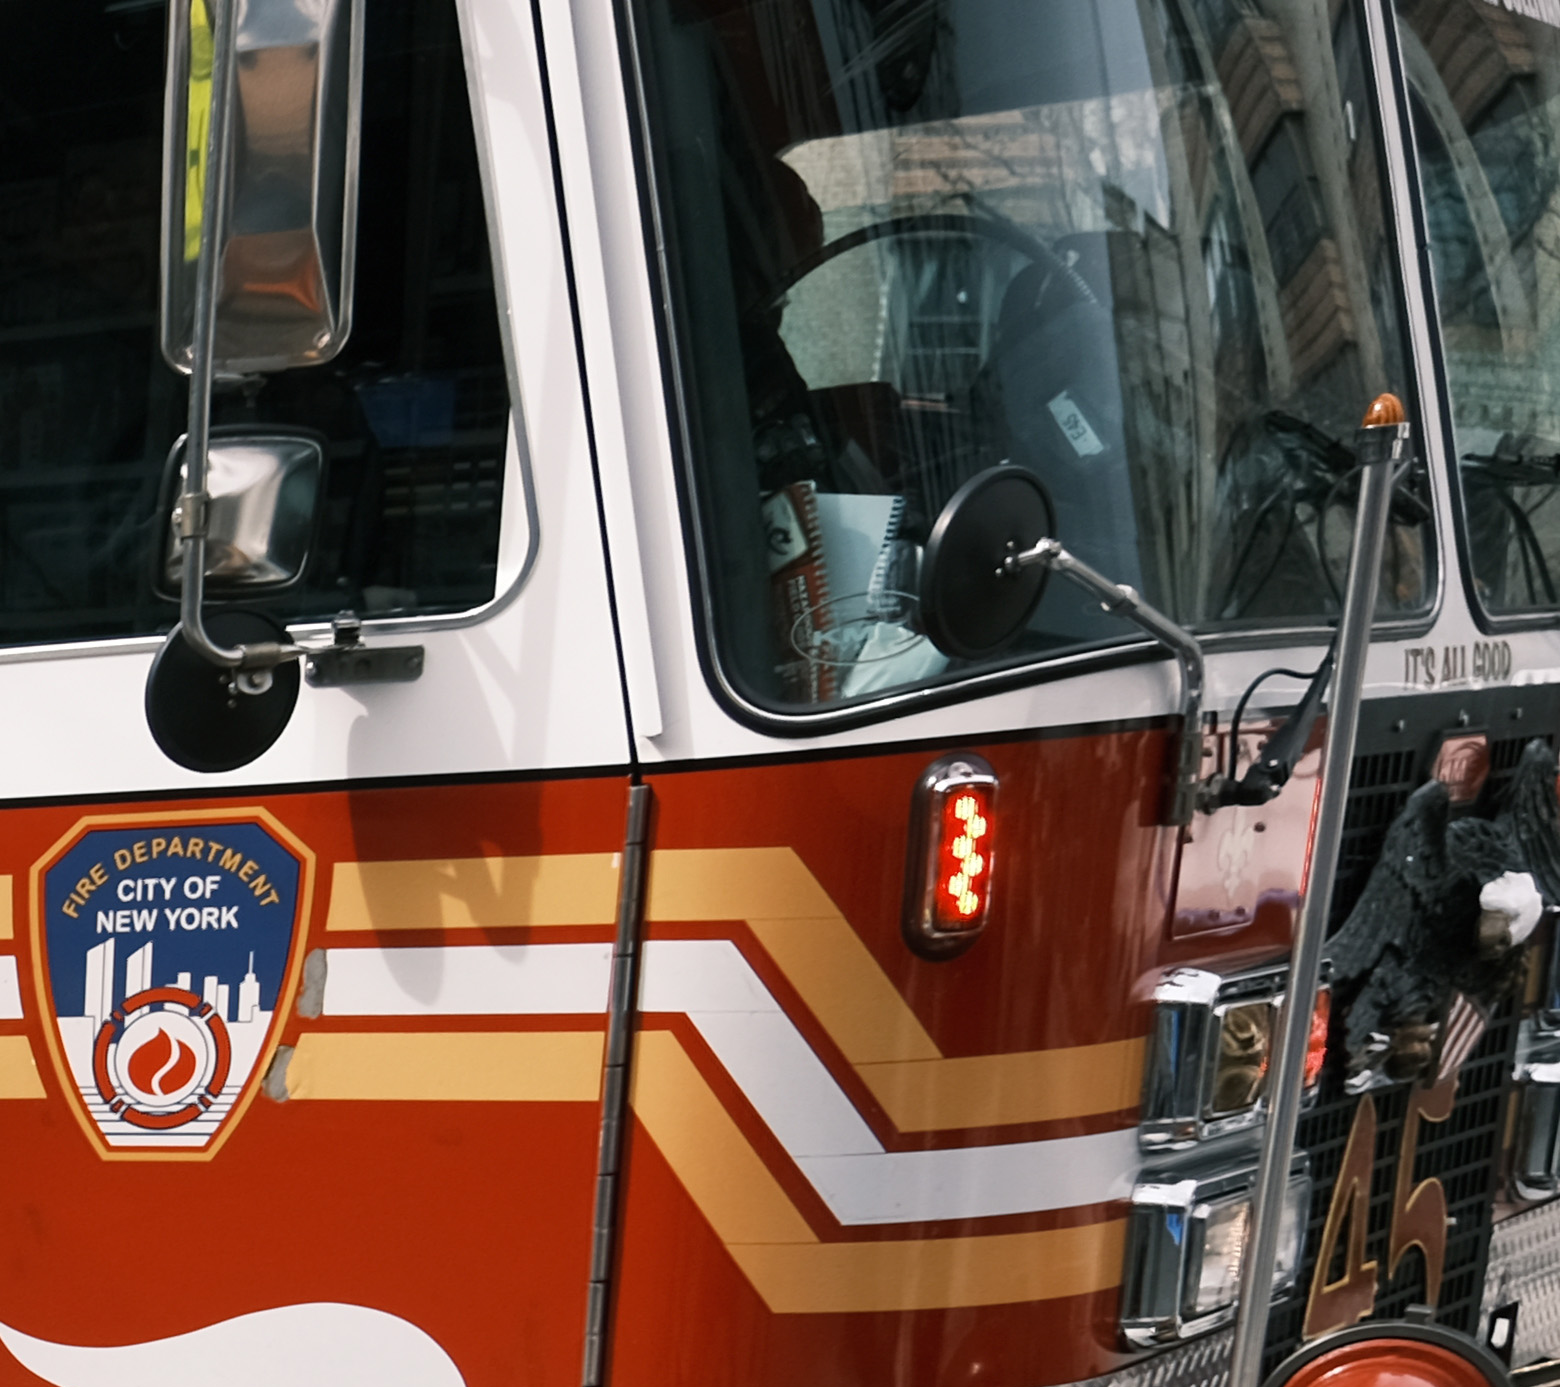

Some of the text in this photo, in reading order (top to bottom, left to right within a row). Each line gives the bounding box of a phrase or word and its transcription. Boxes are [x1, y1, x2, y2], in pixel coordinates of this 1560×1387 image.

[1404, 640, 1512, 687] IT'S ALL GOOD
[61, 836, 281, 920] FIRE DEPARTMENT
[117, 874, 221, 904] CITY OF
[96, 905, 240, 935] NEW YORK
